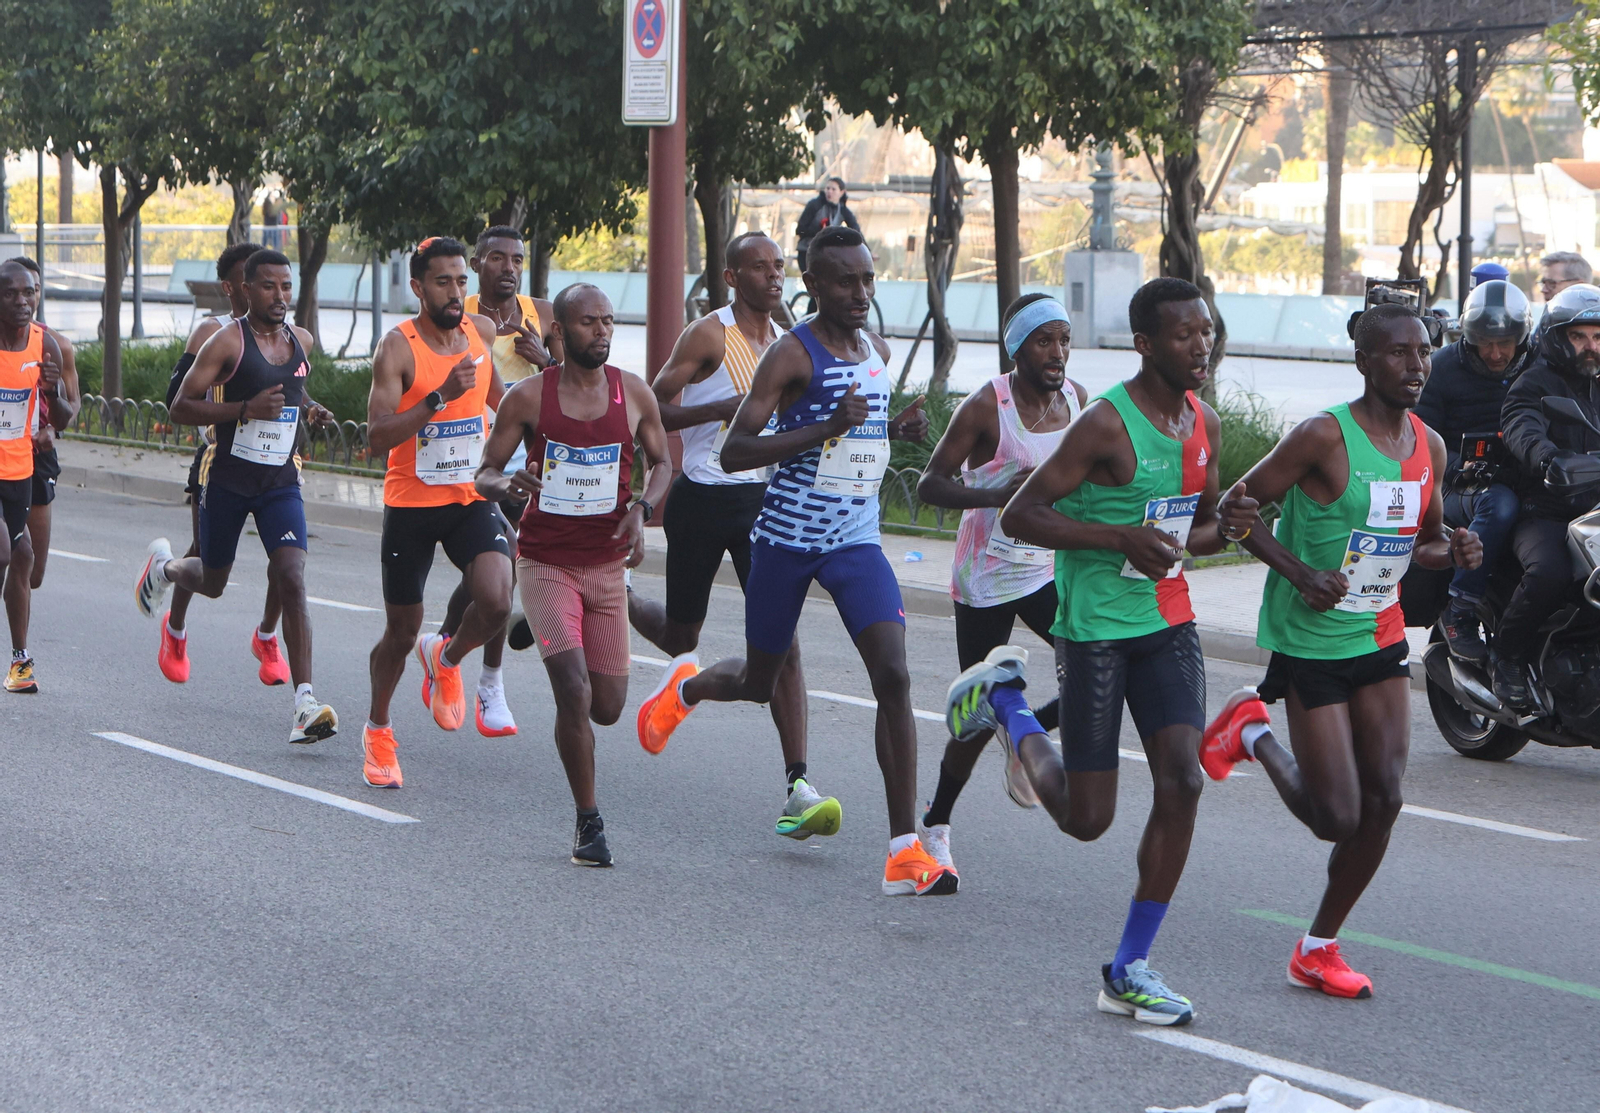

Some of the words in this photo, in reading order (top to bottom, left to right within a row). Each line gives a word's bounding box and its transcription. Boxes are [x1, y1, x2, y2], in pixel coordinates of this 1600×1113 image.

[0, 392, 26, 401] URICH
[442, 422, 477, 435] ZURICH
[257, 430, 281, 441] ZEWDU
[262, 443, 271, 451] 14
[449, 446, 455, 456] 5
[573, 451, 611, 463] ZURICH
[849, 453, 876, 464] GELETA
[435, 458, 470, 470] AMDOUNI
[857, 469, 864, 479] 6
[565, 476, 601, 487] HIYRDEN
[577, 492, 585, 501] 2
[1391, 487, 1404, 506] 36
[1169, 501, 1198, 514] ZURIC
[1381, 541, 1413, 553] ZURIC
[1378, 567, 1393, 579] 36
